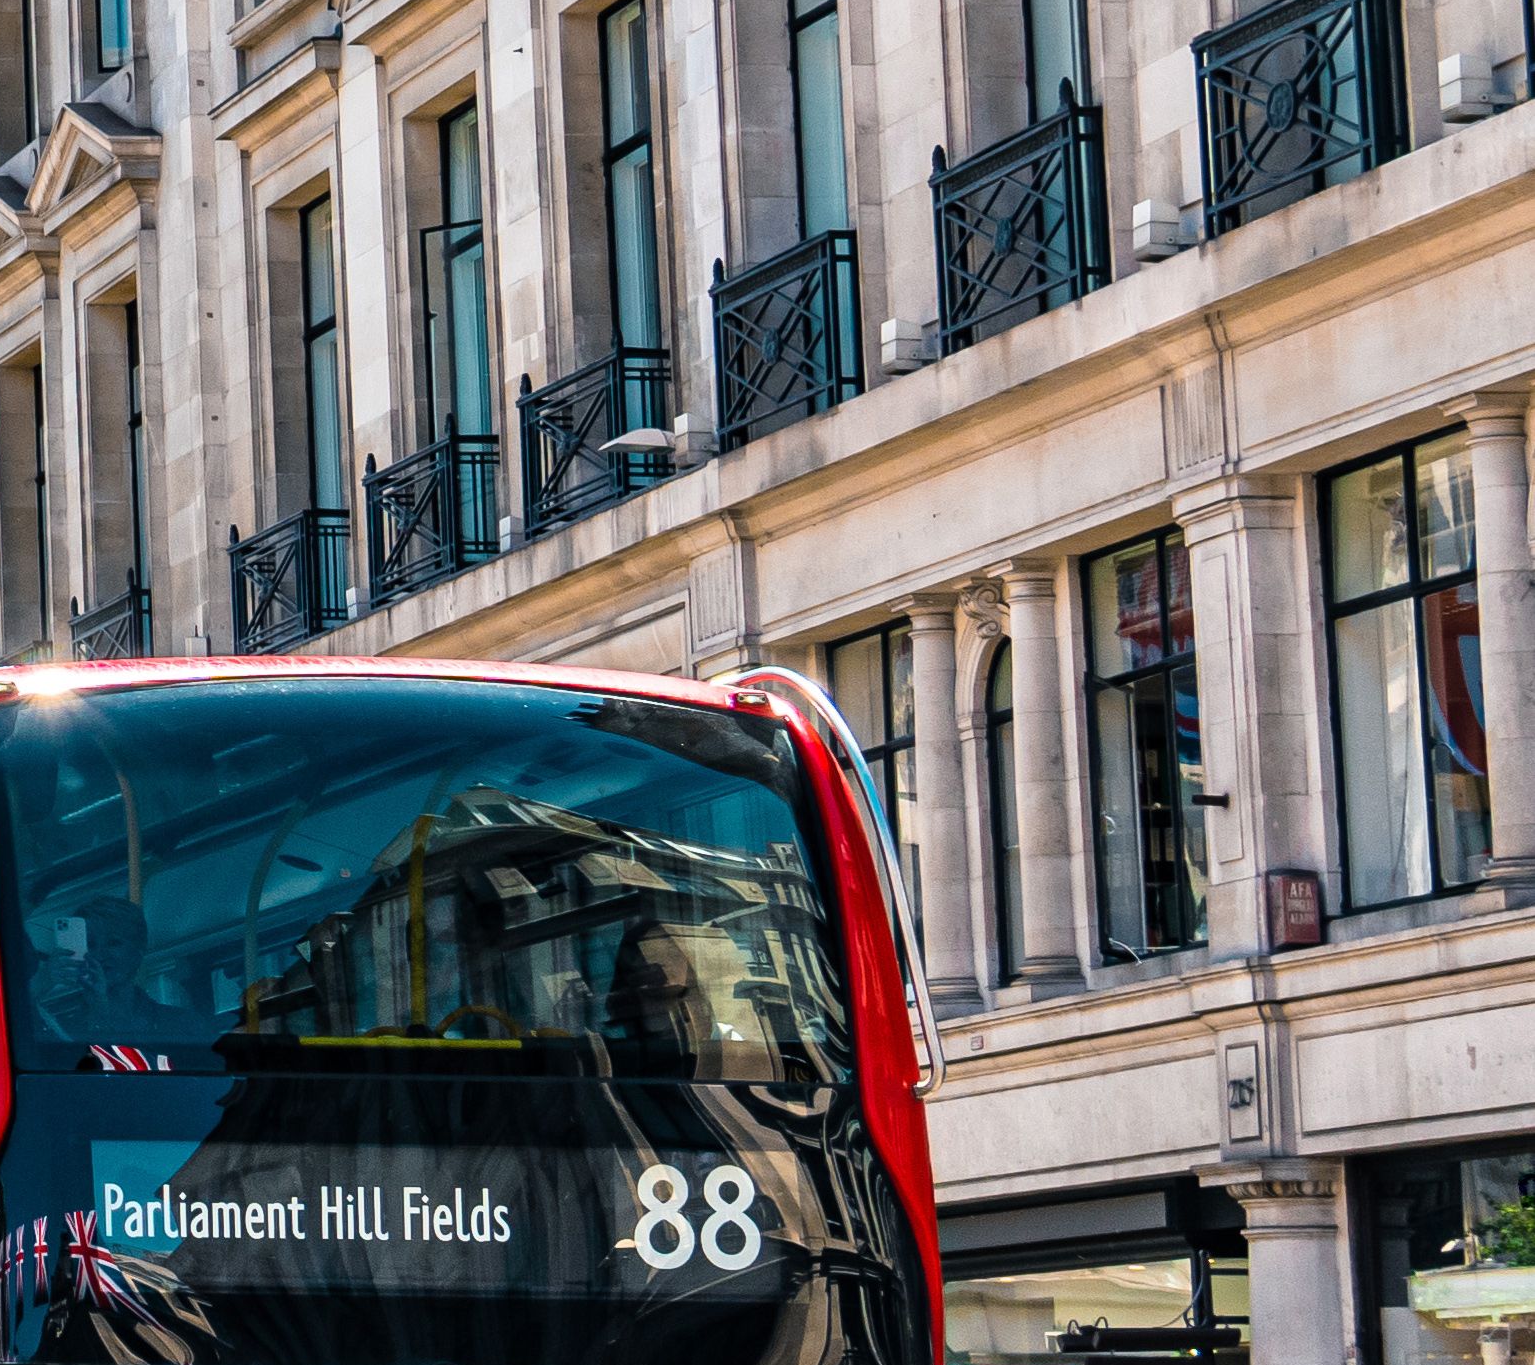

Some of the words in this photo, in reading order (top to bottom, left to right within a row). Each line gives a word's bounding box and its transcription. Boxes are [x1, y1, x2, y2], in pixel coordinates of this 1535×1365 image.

[1289, 882, 1313, 898] AFA
[1228, 1076, 1255, 1110] 215
[104, 1183, 306, 1240] Parliament
[321, 1185, 390, 1242] Hill
[403, 1186, 511, 1244] Fields
[634, 1163, 762, 1271] 88
